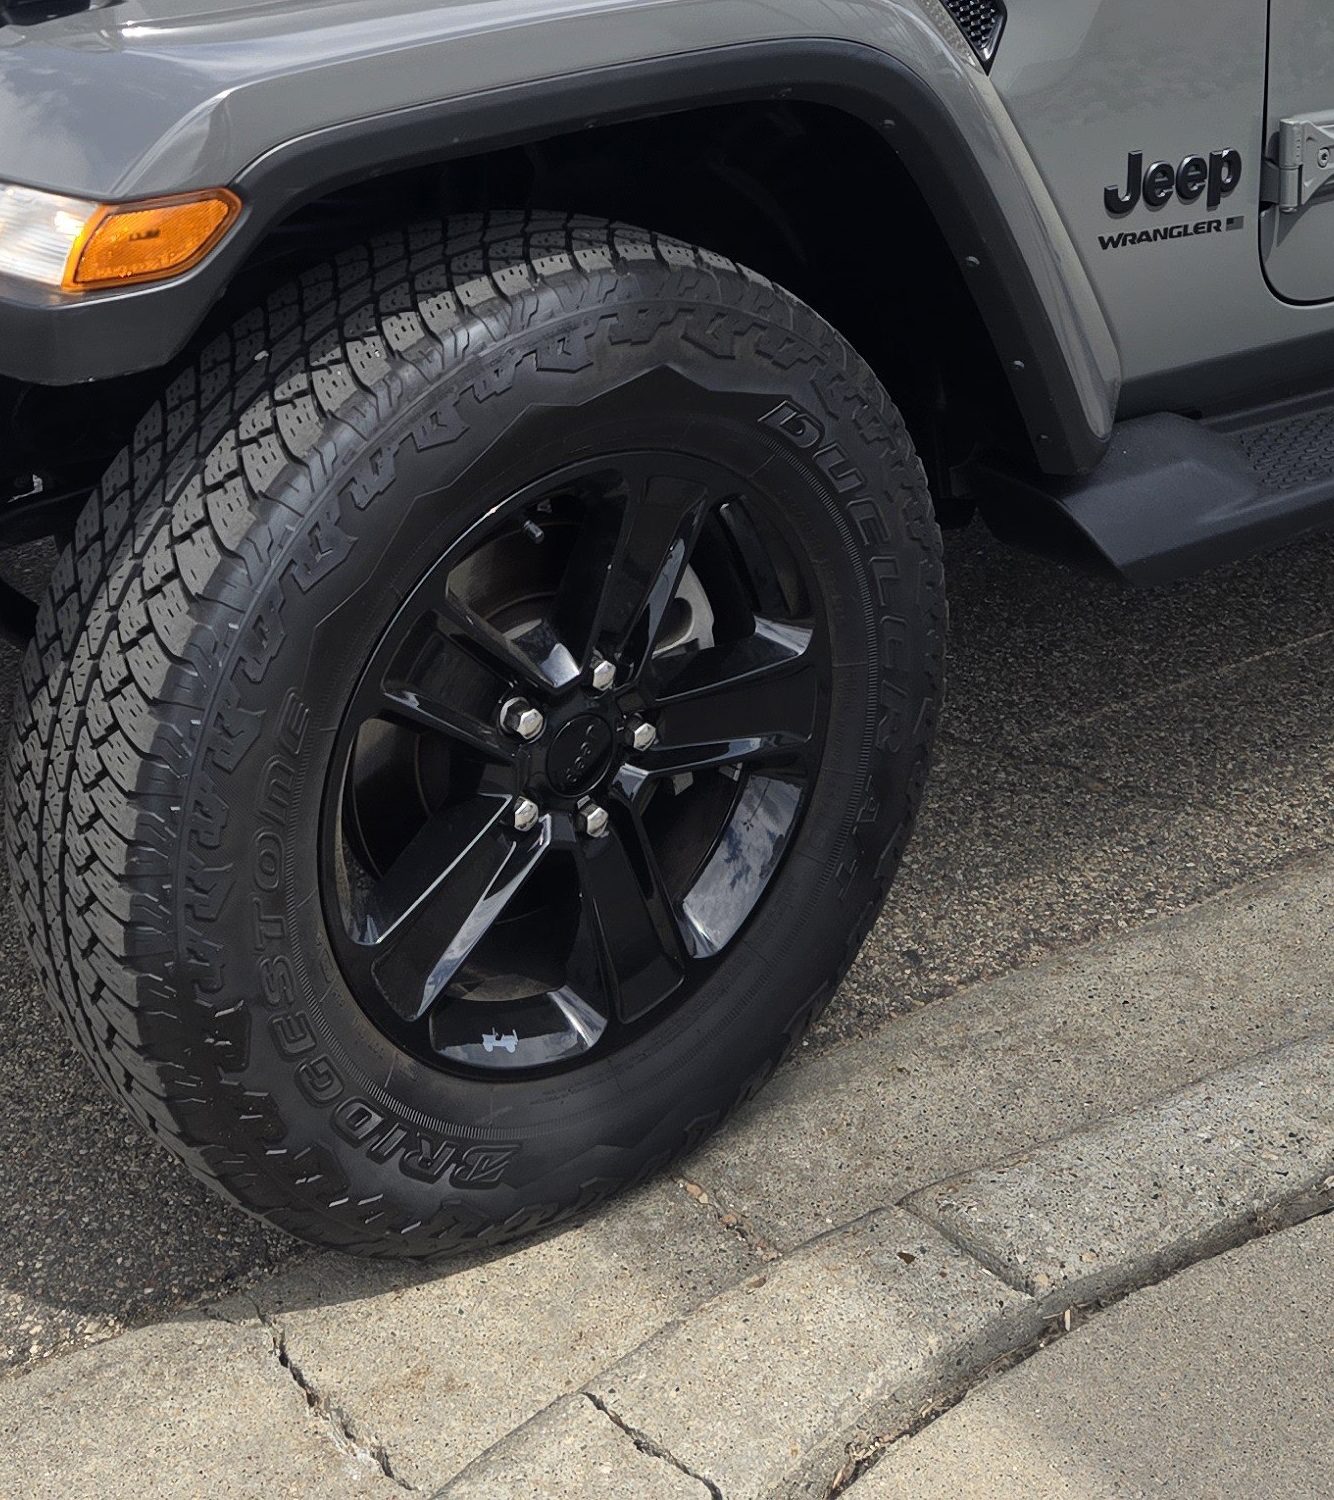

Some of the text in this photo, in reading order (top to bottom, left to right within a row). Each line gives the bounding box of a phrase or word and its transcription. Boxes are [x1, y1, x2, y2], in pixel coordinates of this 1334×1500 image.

[1103, 147, 1242, 214] Jeep
[1098, 218, 1222, 250] WRANGLER
[248, 685, 522, 1190] BRIDGESTONE
